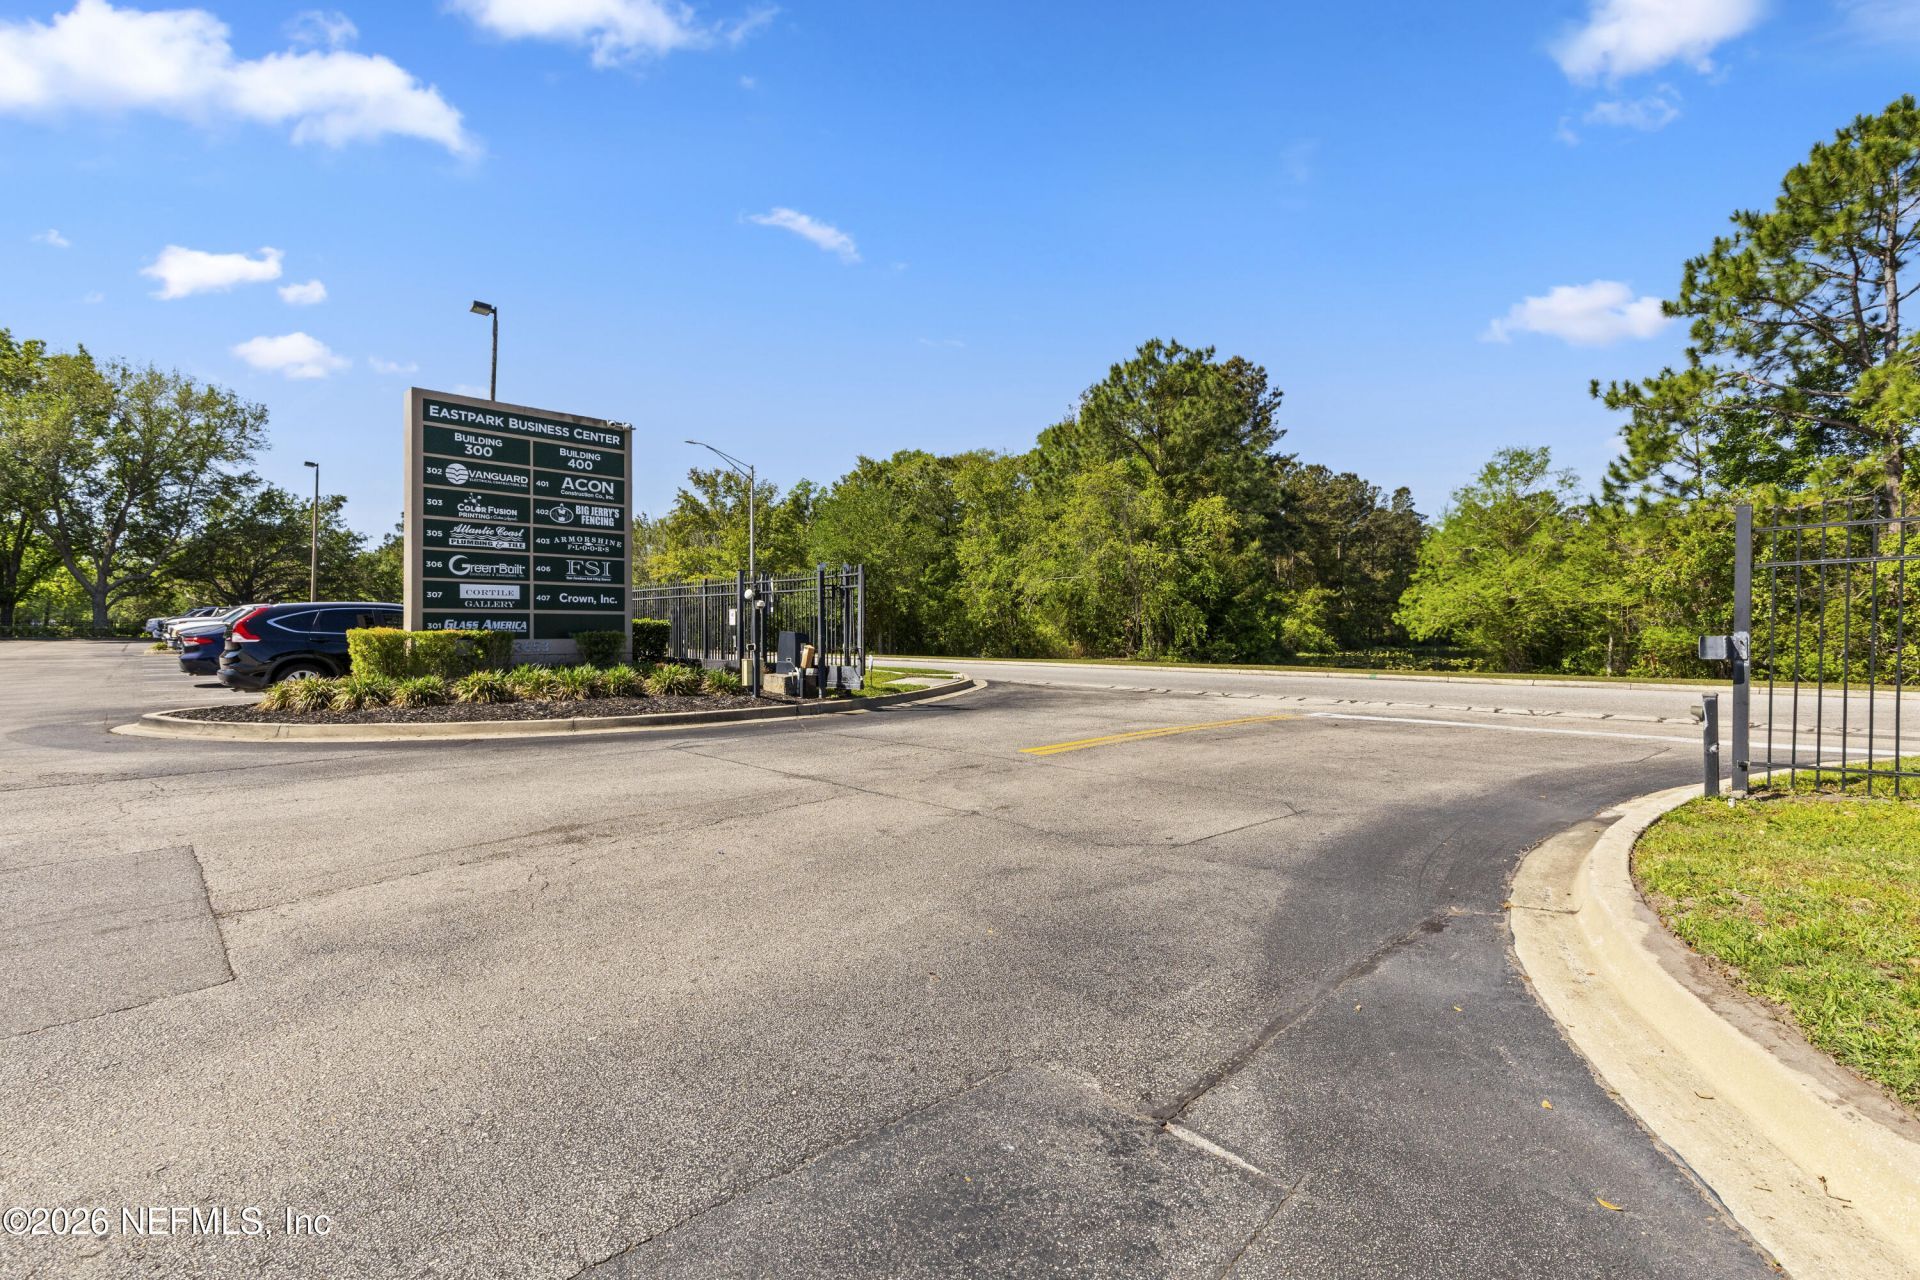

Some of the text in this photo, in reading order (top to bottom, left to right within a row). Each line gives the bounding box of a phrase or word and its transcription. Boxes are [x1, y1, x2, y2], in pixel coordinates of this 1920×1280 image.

[429, 405, 620, 445] EASTPARK BUSINESS CENTER
[454, 432, 503, 447] BUILDING
[464, 444, 493, 457] 300
[559, 448, 601, 461] BUILDING
[567, 459, 593, 470] 400
[426, 467, 442, 475] 302
[468, 469, 529, 484] VANGUARD
[561, 477, 614, 494] ACON
[560, 490, 594, 498] Construction
[426, 498, 443, 506] 303
[458, 512, 490, 520] PRINTING
[488, 505, 518, 516] FUSION
[575, 504, 620, 518] BIG JERRY'S
[581, 515, 615, 526] FENCING
[426, 529, 443, 537] 305
[450, 523, 525, 537] Atlantic Coast
[450, 538, 493, 547] PLUMBING
[495, 541, 504, 549] &
[553, 535, 622, 548] ARMORSHINE
[425, 560, 443, 568] 306
[566, 559, 612, 577] FSI
[465, 589, 515, 597] CORTILE
[559, 592, 618, 605] Crown, Inc.
[464, 600, 515, 608] GALLERY
[444, 619, 527, 630] GLASS AMERICA
